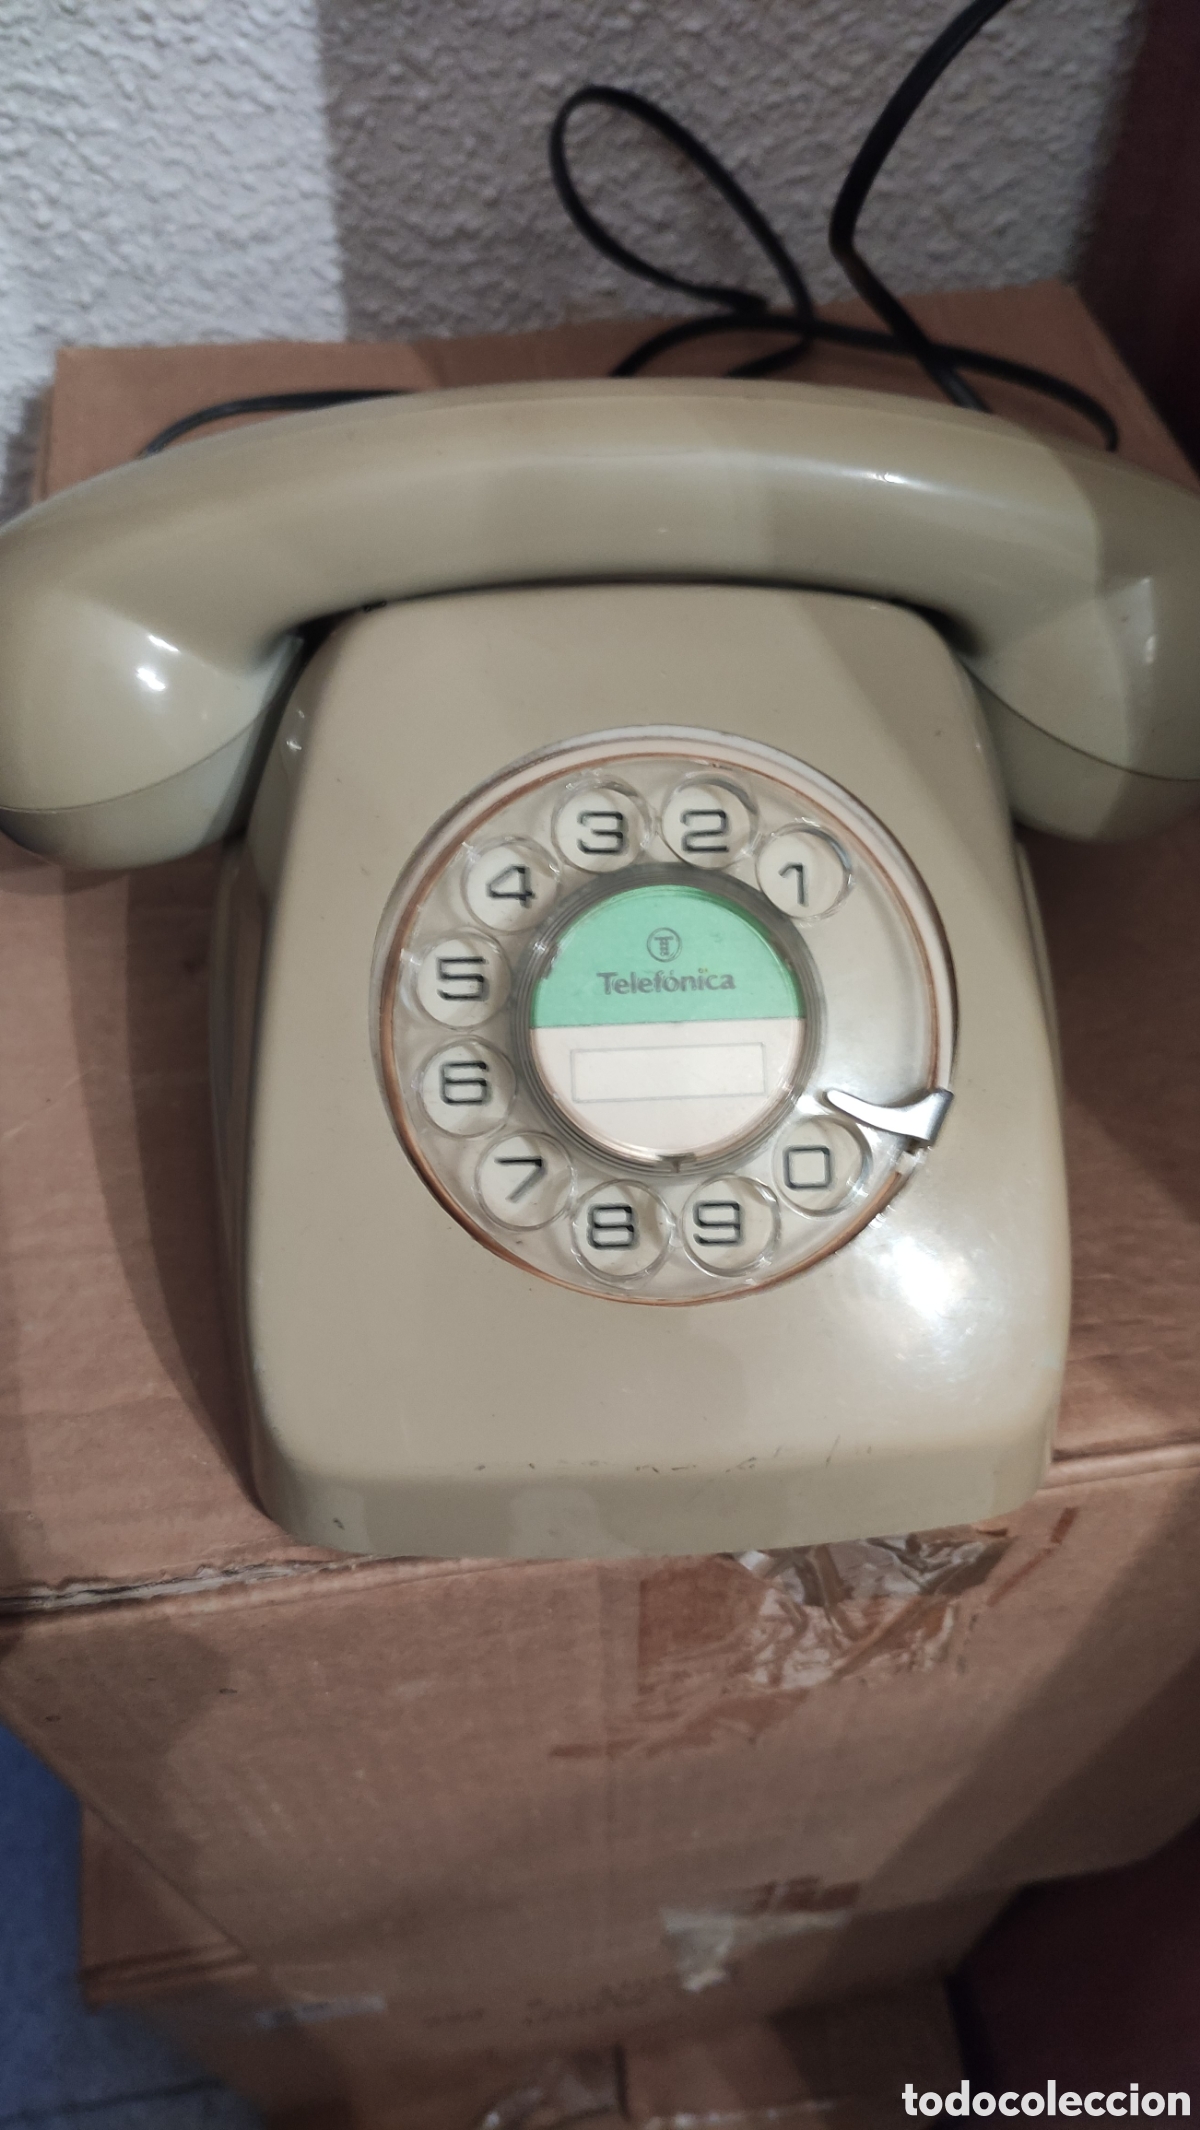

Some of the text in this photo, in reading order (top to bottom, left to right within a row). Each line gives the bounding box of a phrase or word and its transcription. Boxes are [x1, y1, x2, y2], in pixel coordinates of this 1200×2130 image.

[576, 810, 625, 855] 3
[680, 809, 730, 853] 2
[486, 865, 534, 909] 4
[778, 861, 806, 907] 1
[436, 956, 486, 1001] 5
[596, 968, 736, 995] Telefónica
[438, 1060, 490, 1106] 6
[494, 1157, 543, 1202] 7
[783, 1146, 832, 1190] 0
[586, 1203, 635, 1250] 8
[692, 1201, 742, 1246] 9
